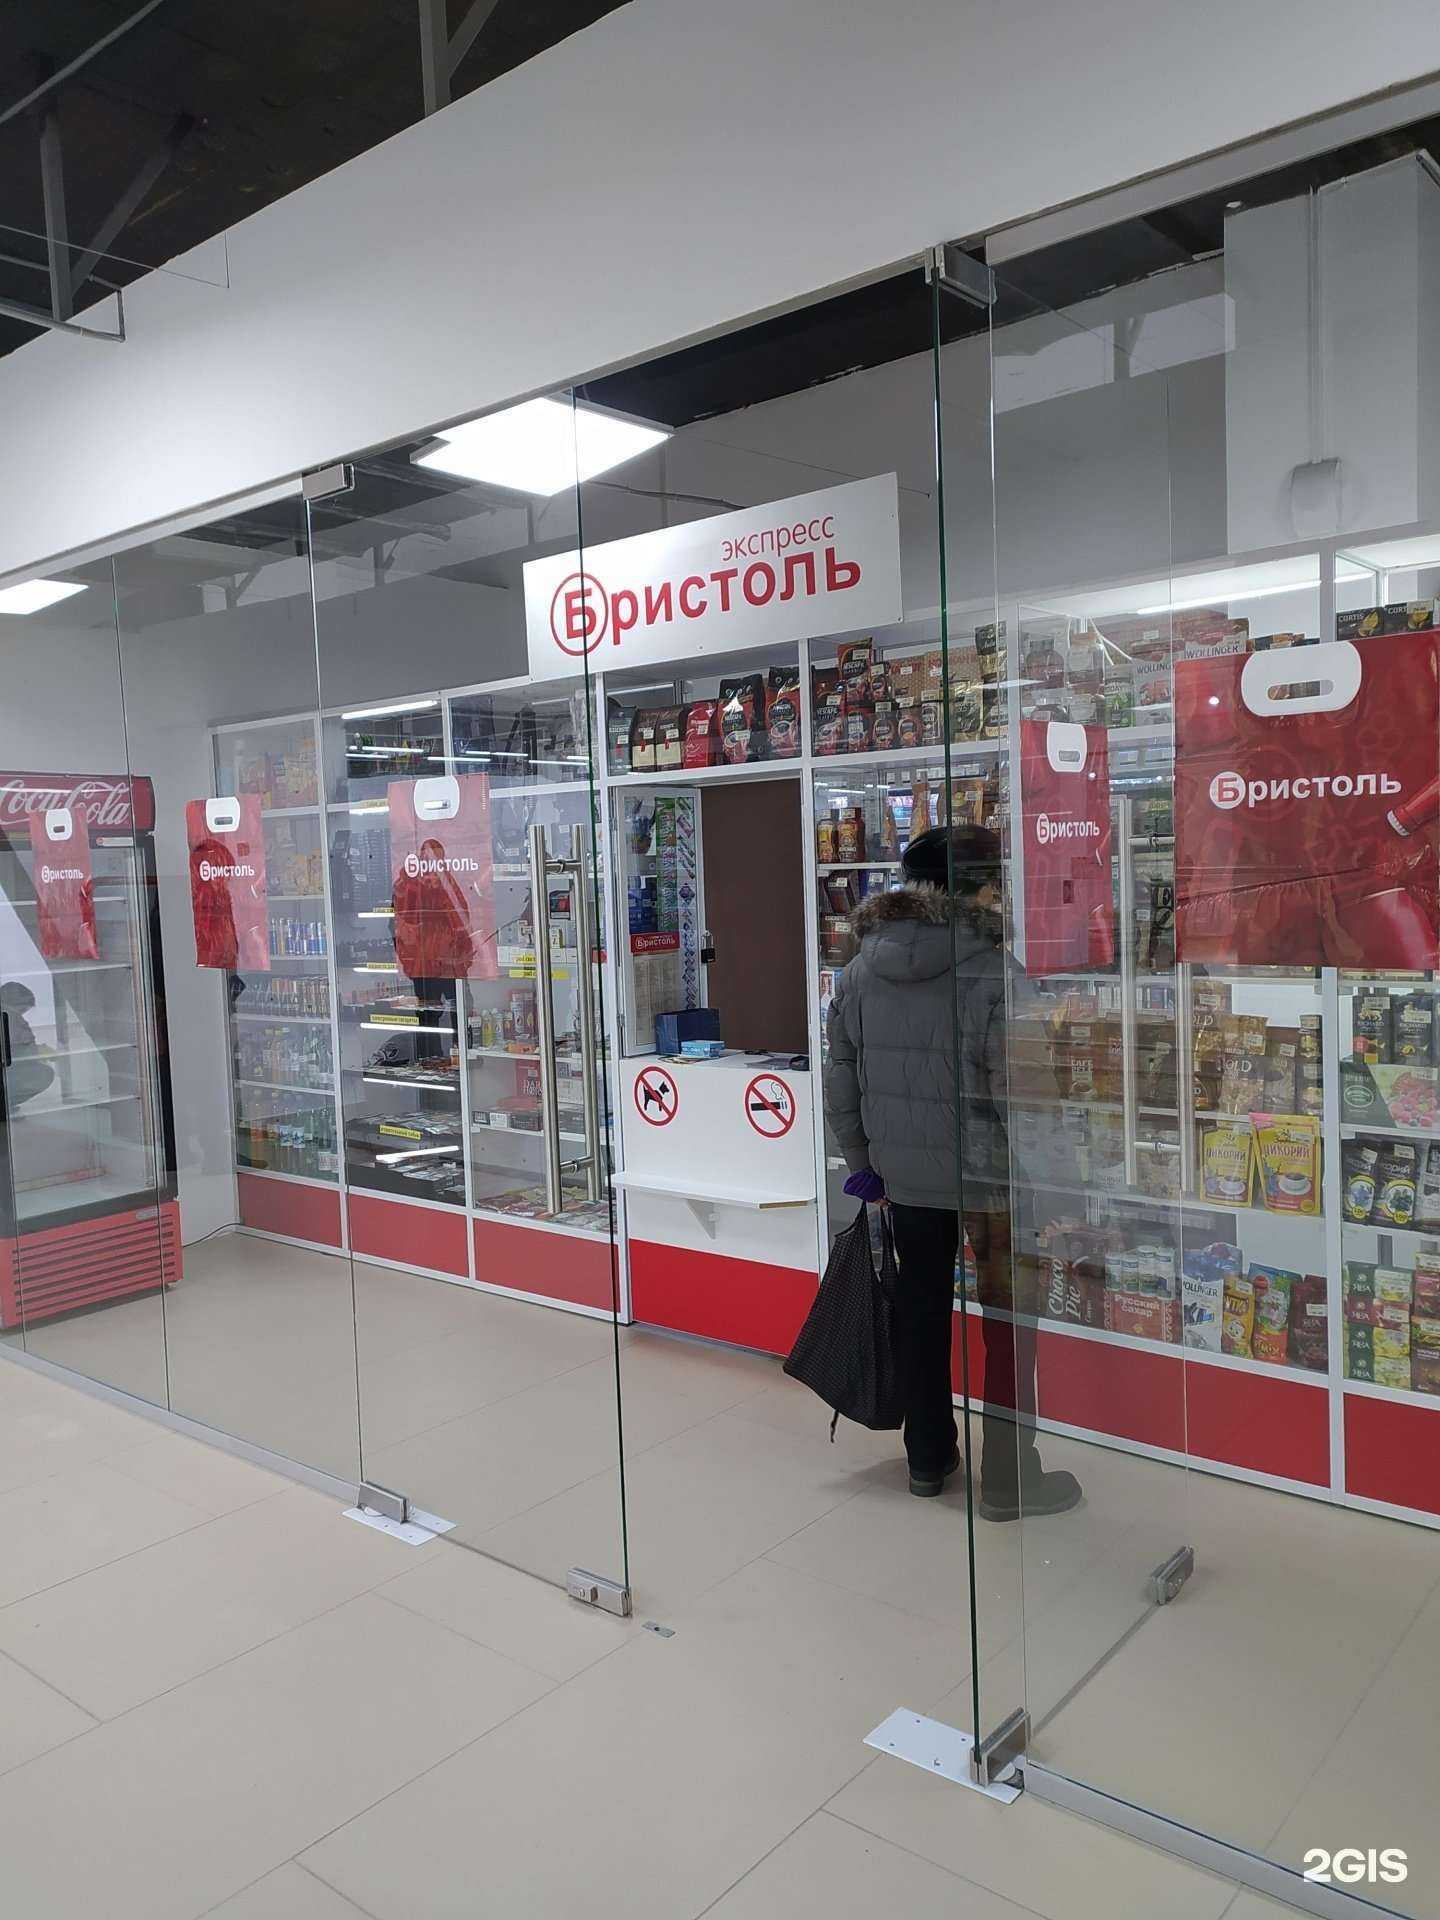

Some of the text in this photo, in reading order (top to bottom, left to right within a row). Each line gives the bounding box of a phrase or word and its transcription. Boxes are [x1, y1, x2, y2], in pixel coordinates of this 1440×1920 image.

[722, 516, 834, 562] экспресс
[551, 547, 862, 656] Бристоль
[1209, 771, 1402, 809] Бристоль
[1036, 813, 1100, 844] Бристоль
[42, 865, 84, 883] Бристоль
[200, 860, 255, 881] Бристоль
[404, 853, 479, 878] Бристоль
[1048, 1257, 1064, 1315] Choco
[1065, 1285, 1081, 1321] Pie
